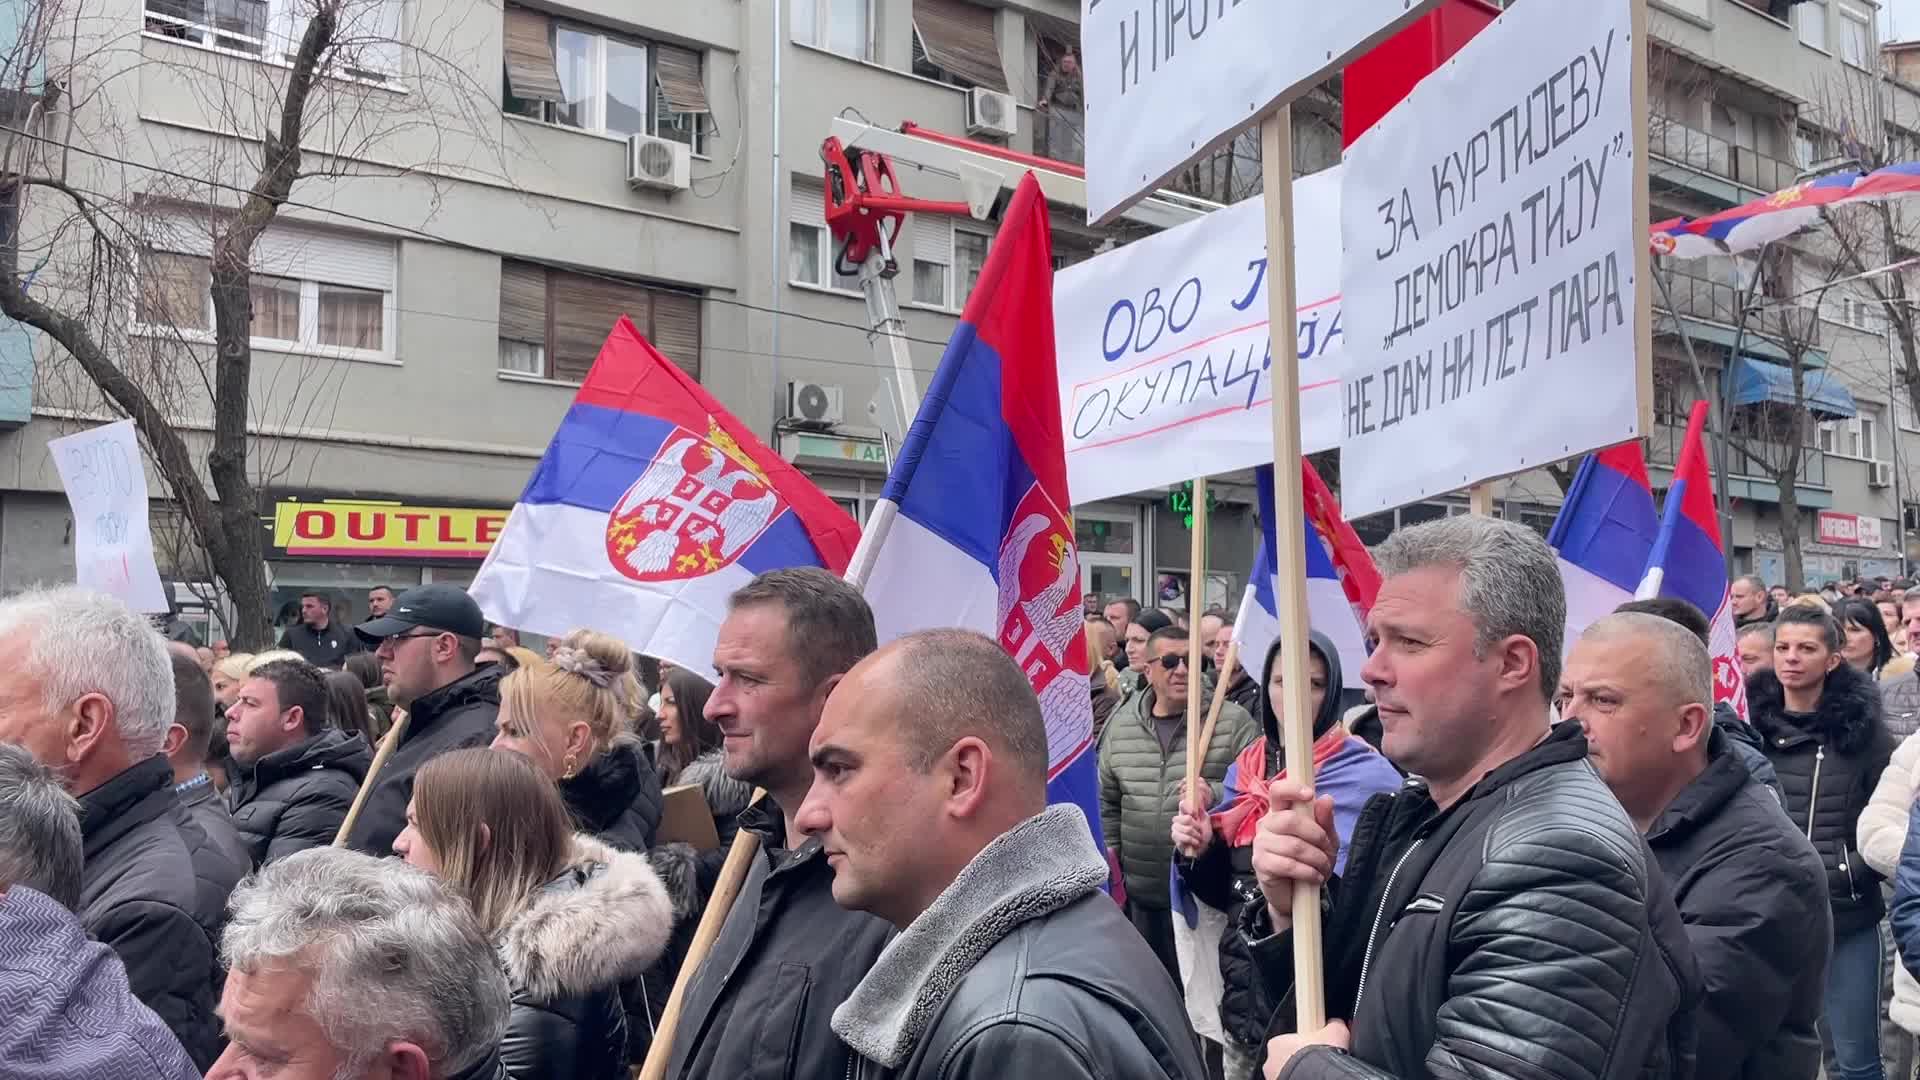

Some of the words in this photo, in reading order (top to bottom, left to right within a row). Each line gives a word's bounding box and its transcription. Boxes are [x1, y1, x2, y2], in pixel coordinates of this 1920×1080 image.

[1119, 10, 1139, 95] И
[1151, 0, 1249, 72] ПРО
[1376, 187, 1420, 261] ЗА
[1431, 28, 1615, 227] КУРТИЈЕВУ
[1102, 277, 1202, 361] ОВО
[1230, 257, 1268, 311] Ј
[1348, 374, 1376, 439] НЕ
[1381, 350, 1433, 431] ДАМ
[1440, 328, 1475, 404] НИ
[1482, 296, 1539, 387] ПЕТ
[1546, 250, 1624, 361] ПАРА
[1073, 309, 1342, 439] ОКУПАЦЈА
[295, 510, 508, 543] OUTLE
